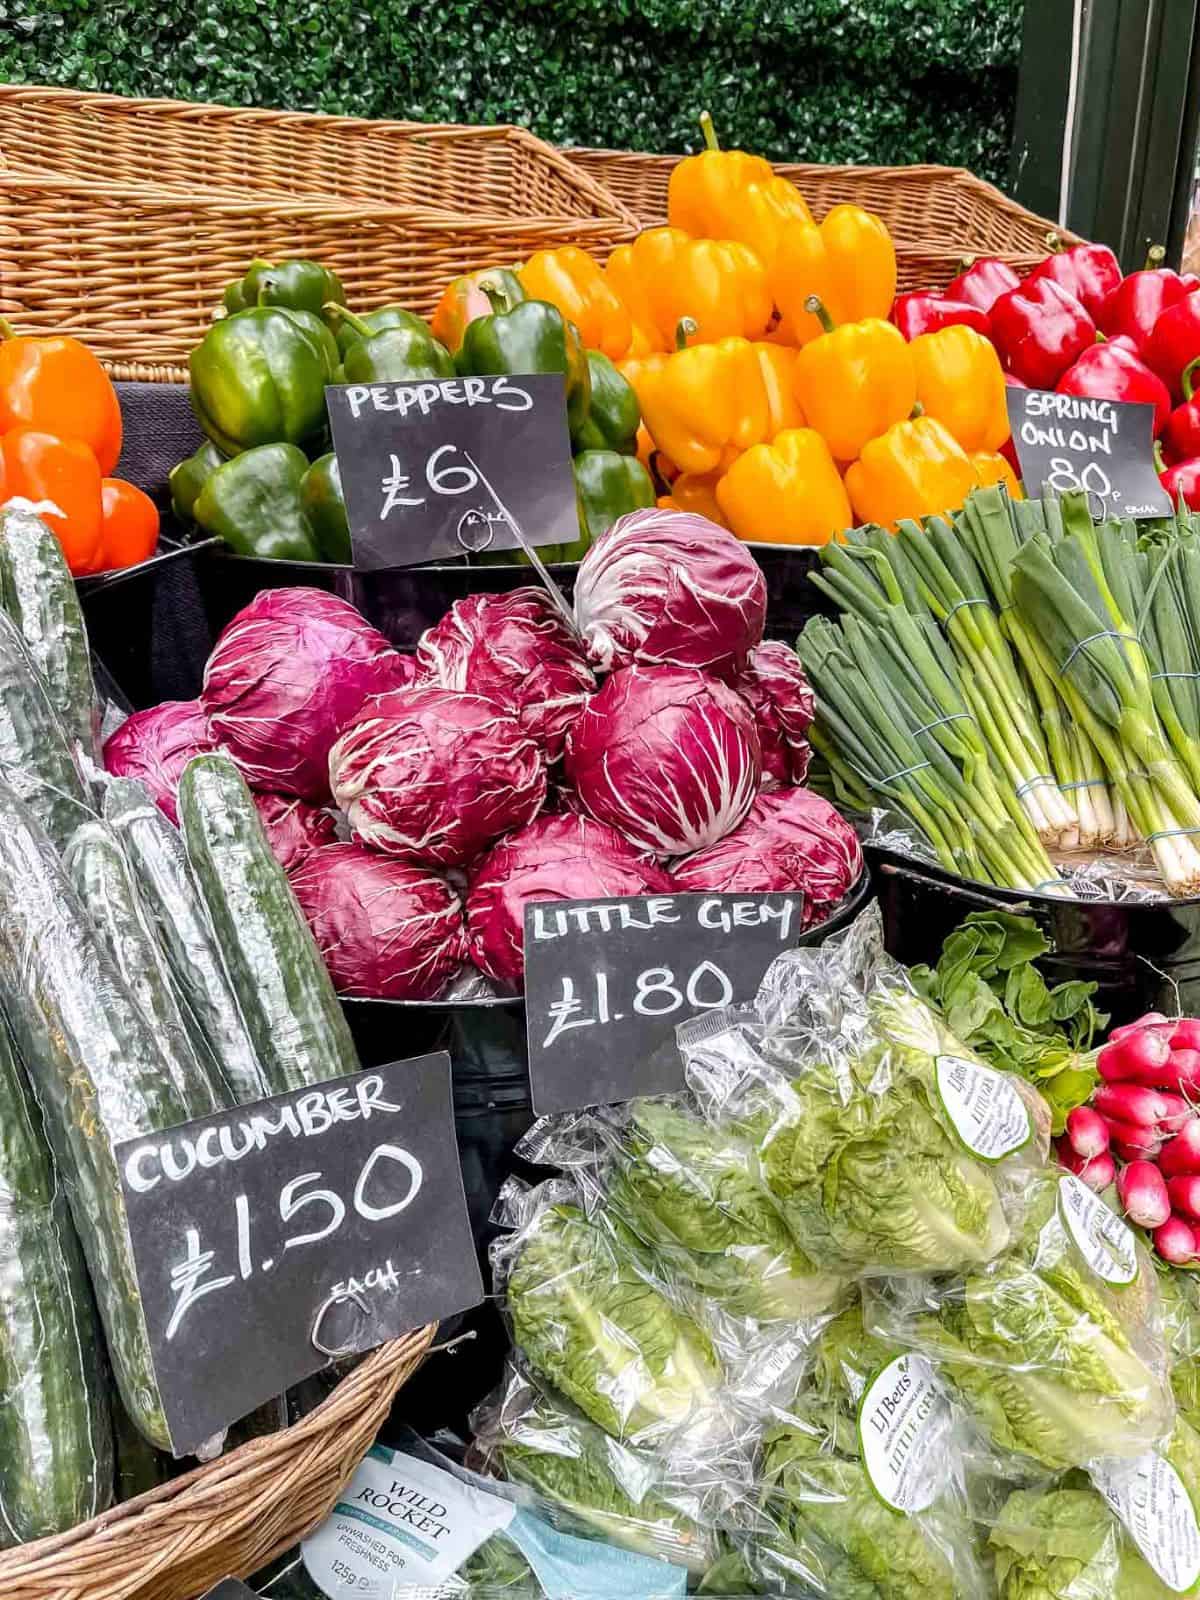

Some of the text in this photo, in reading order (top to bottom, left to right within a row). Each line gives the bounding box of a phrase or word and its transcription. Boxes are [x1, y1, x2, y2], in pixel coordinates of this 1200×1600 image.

[345, 377, 534, 418] PEPPERS
[1025, 393, 1119, 434] SPRING
[1020, 422, 1112, 455] ONION
[533, 899, 794, 940] LITTLE GEM
[542, 960, 733, 1048] £1.80
[124, 1075, 402, 1193] CUCUMBER
[164, 1143, 423, 1341] £1.50
[328, 1259, 404, 1306] EACH
[881, 1373, 913, 1416] Betts
[355, 1487, 451, 1540] ROCKET
[389, 1480, 448, 1519] WILD
[336, 1521, 407, 1569] UNWASHED FOR
[338, 1534, 391, 1572] FRESHNESS
[330, 1559, 357, 1586] 125g
